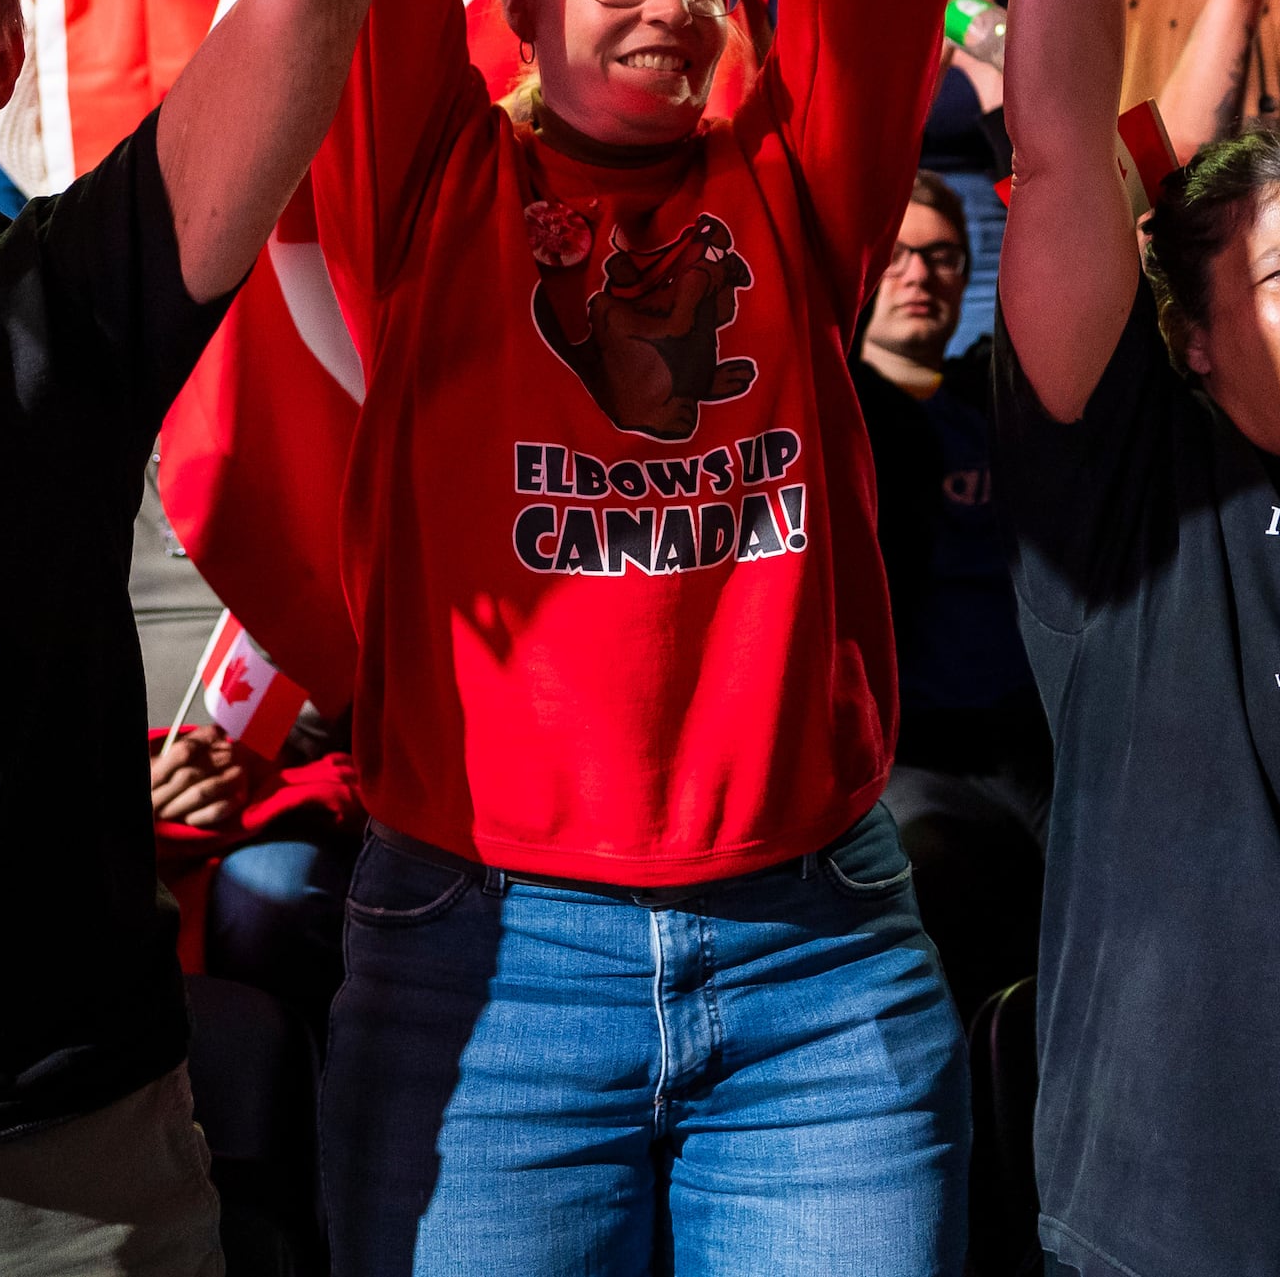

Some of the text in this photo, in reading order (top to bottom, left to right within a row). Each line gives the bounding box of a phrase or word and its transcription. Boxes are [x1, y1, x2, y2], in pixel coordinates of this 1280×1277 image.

[514, 428, 801, 500] ELBOWS UP
[512, 482, 808, 577] CANADA!
